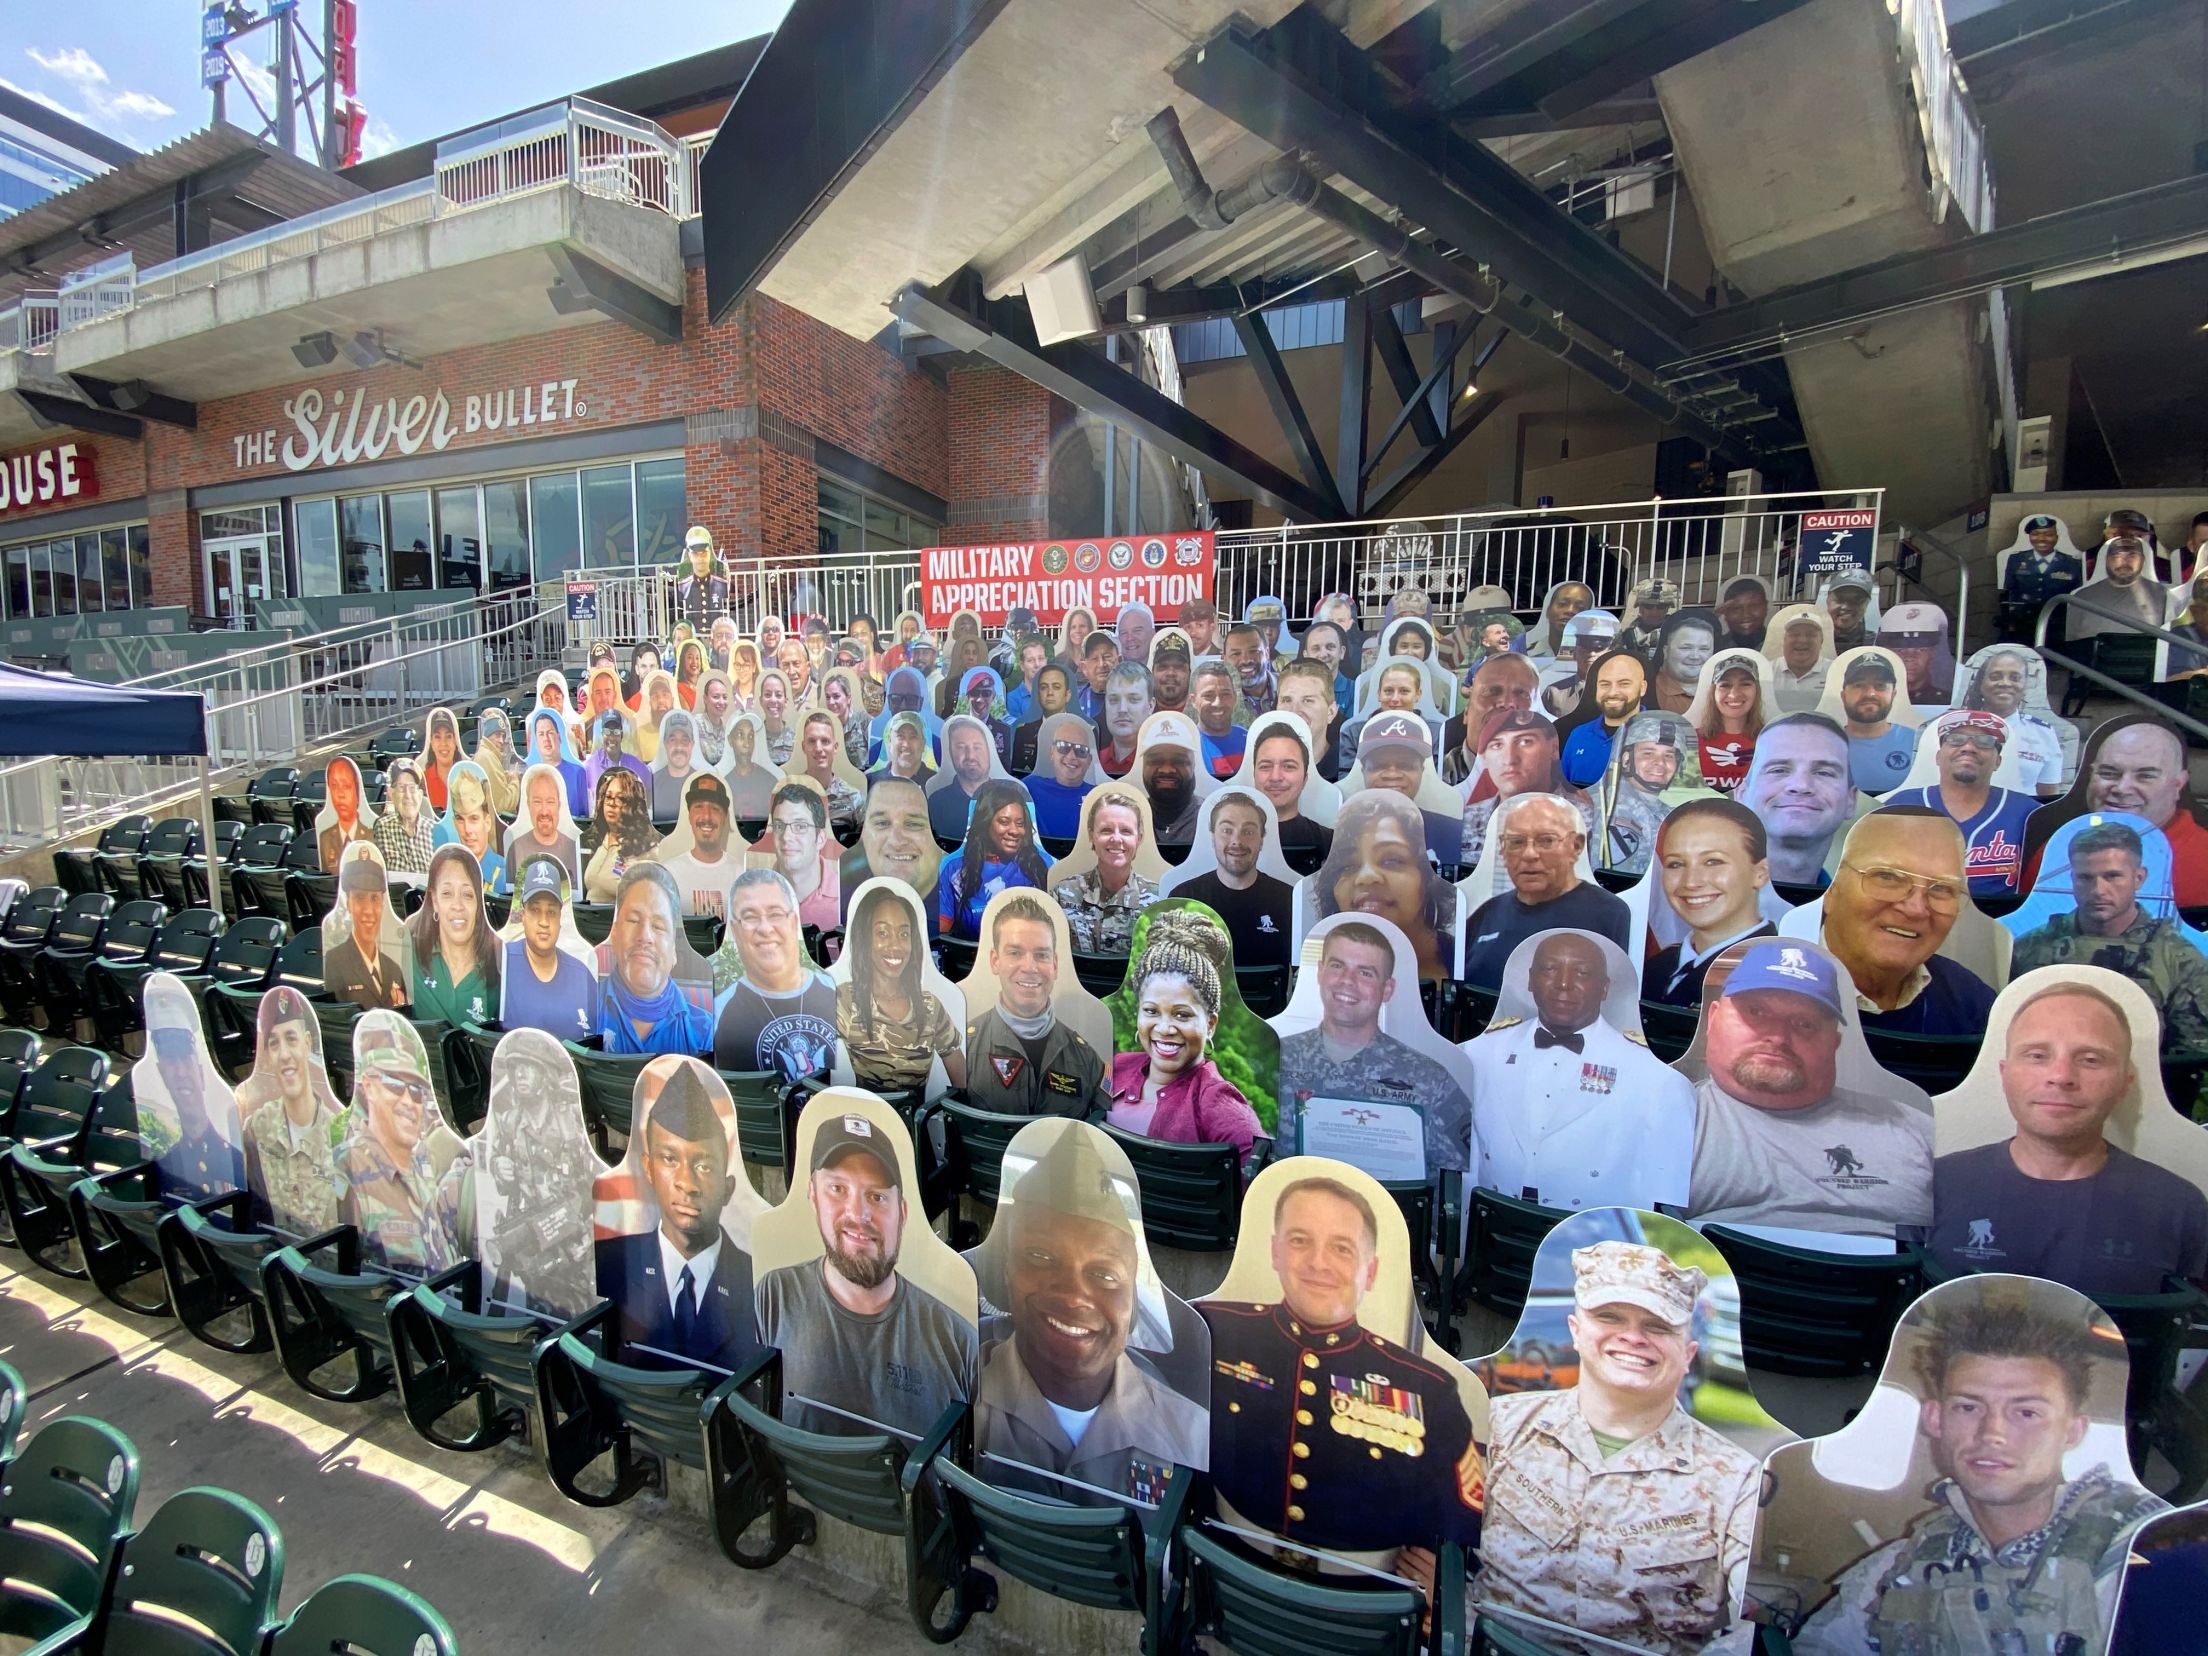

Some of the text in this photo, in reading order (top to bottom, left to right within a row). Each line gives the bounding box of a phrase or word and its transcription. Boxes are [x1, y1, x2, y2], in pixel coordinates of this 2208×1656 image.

[205, 56, 225, 78] 2019
[234, 430, 276, 467] THE
[283, 386, 458, 471] Silver
[1807, 514, 1872, 527] CAUTION
[928, 546, 1034, 580] MILITARY
[1809, 563, 1835, 571] YOUR
[1819, 555, 1853, 563] WATCH
[568, 583, 595, 592] CAUTION
[931, 573, 1202, 614] APPRECIATION SECTION
[1380, 719, 1407, 736] A
[762, 1019, 836, 1053] UNITED STATE
[1391, 1091, 1417, 1104] ARMY
[1516, 1473, 1569, 1518] SOUTHERN
[1643, 1512, 1698, 1531] MARINES
